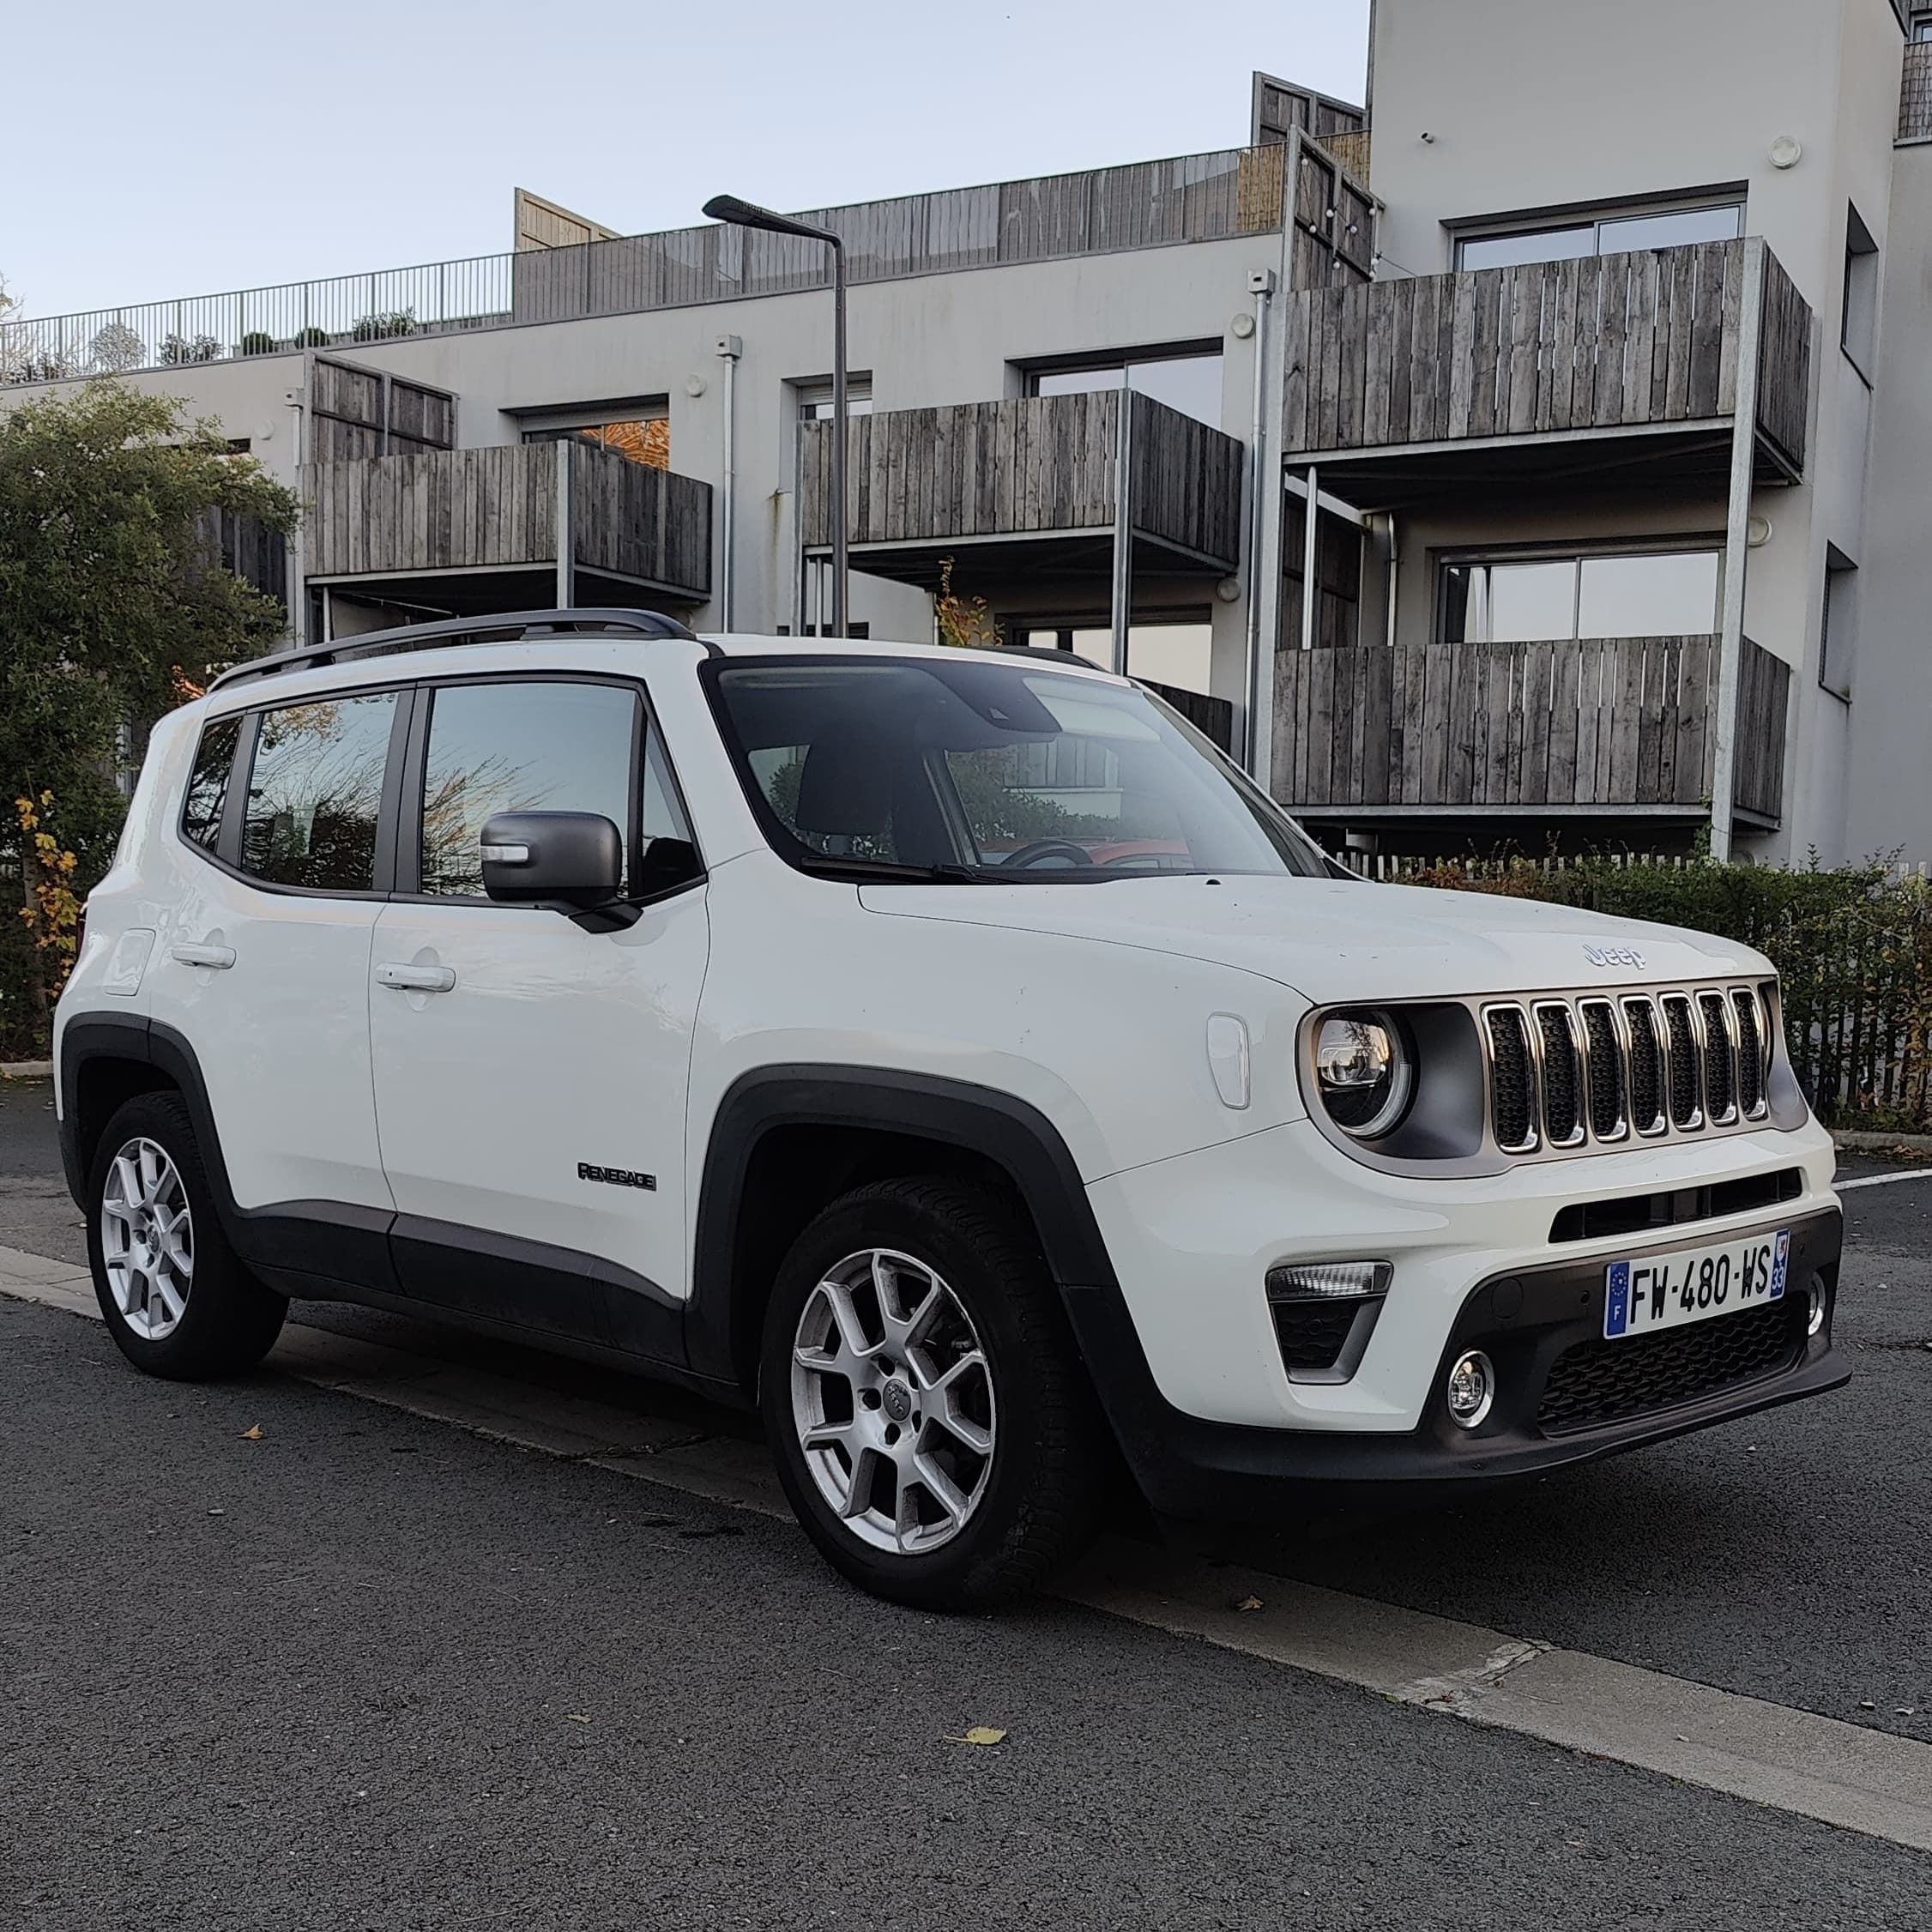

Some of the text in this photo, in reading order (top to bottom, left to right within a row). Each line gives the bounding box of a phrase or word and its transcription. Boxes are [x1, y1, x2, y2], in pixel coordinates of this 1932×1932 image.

[1582, 944, 1646, 970] Jeep
[577, 1162, 657, 1192] RENEGADE
[1630, 1245, 1770, 1324] FW-480-WS
[1772, 1266, 1784, 1290] 33
[1614, 1305, 1621, 1320] F
